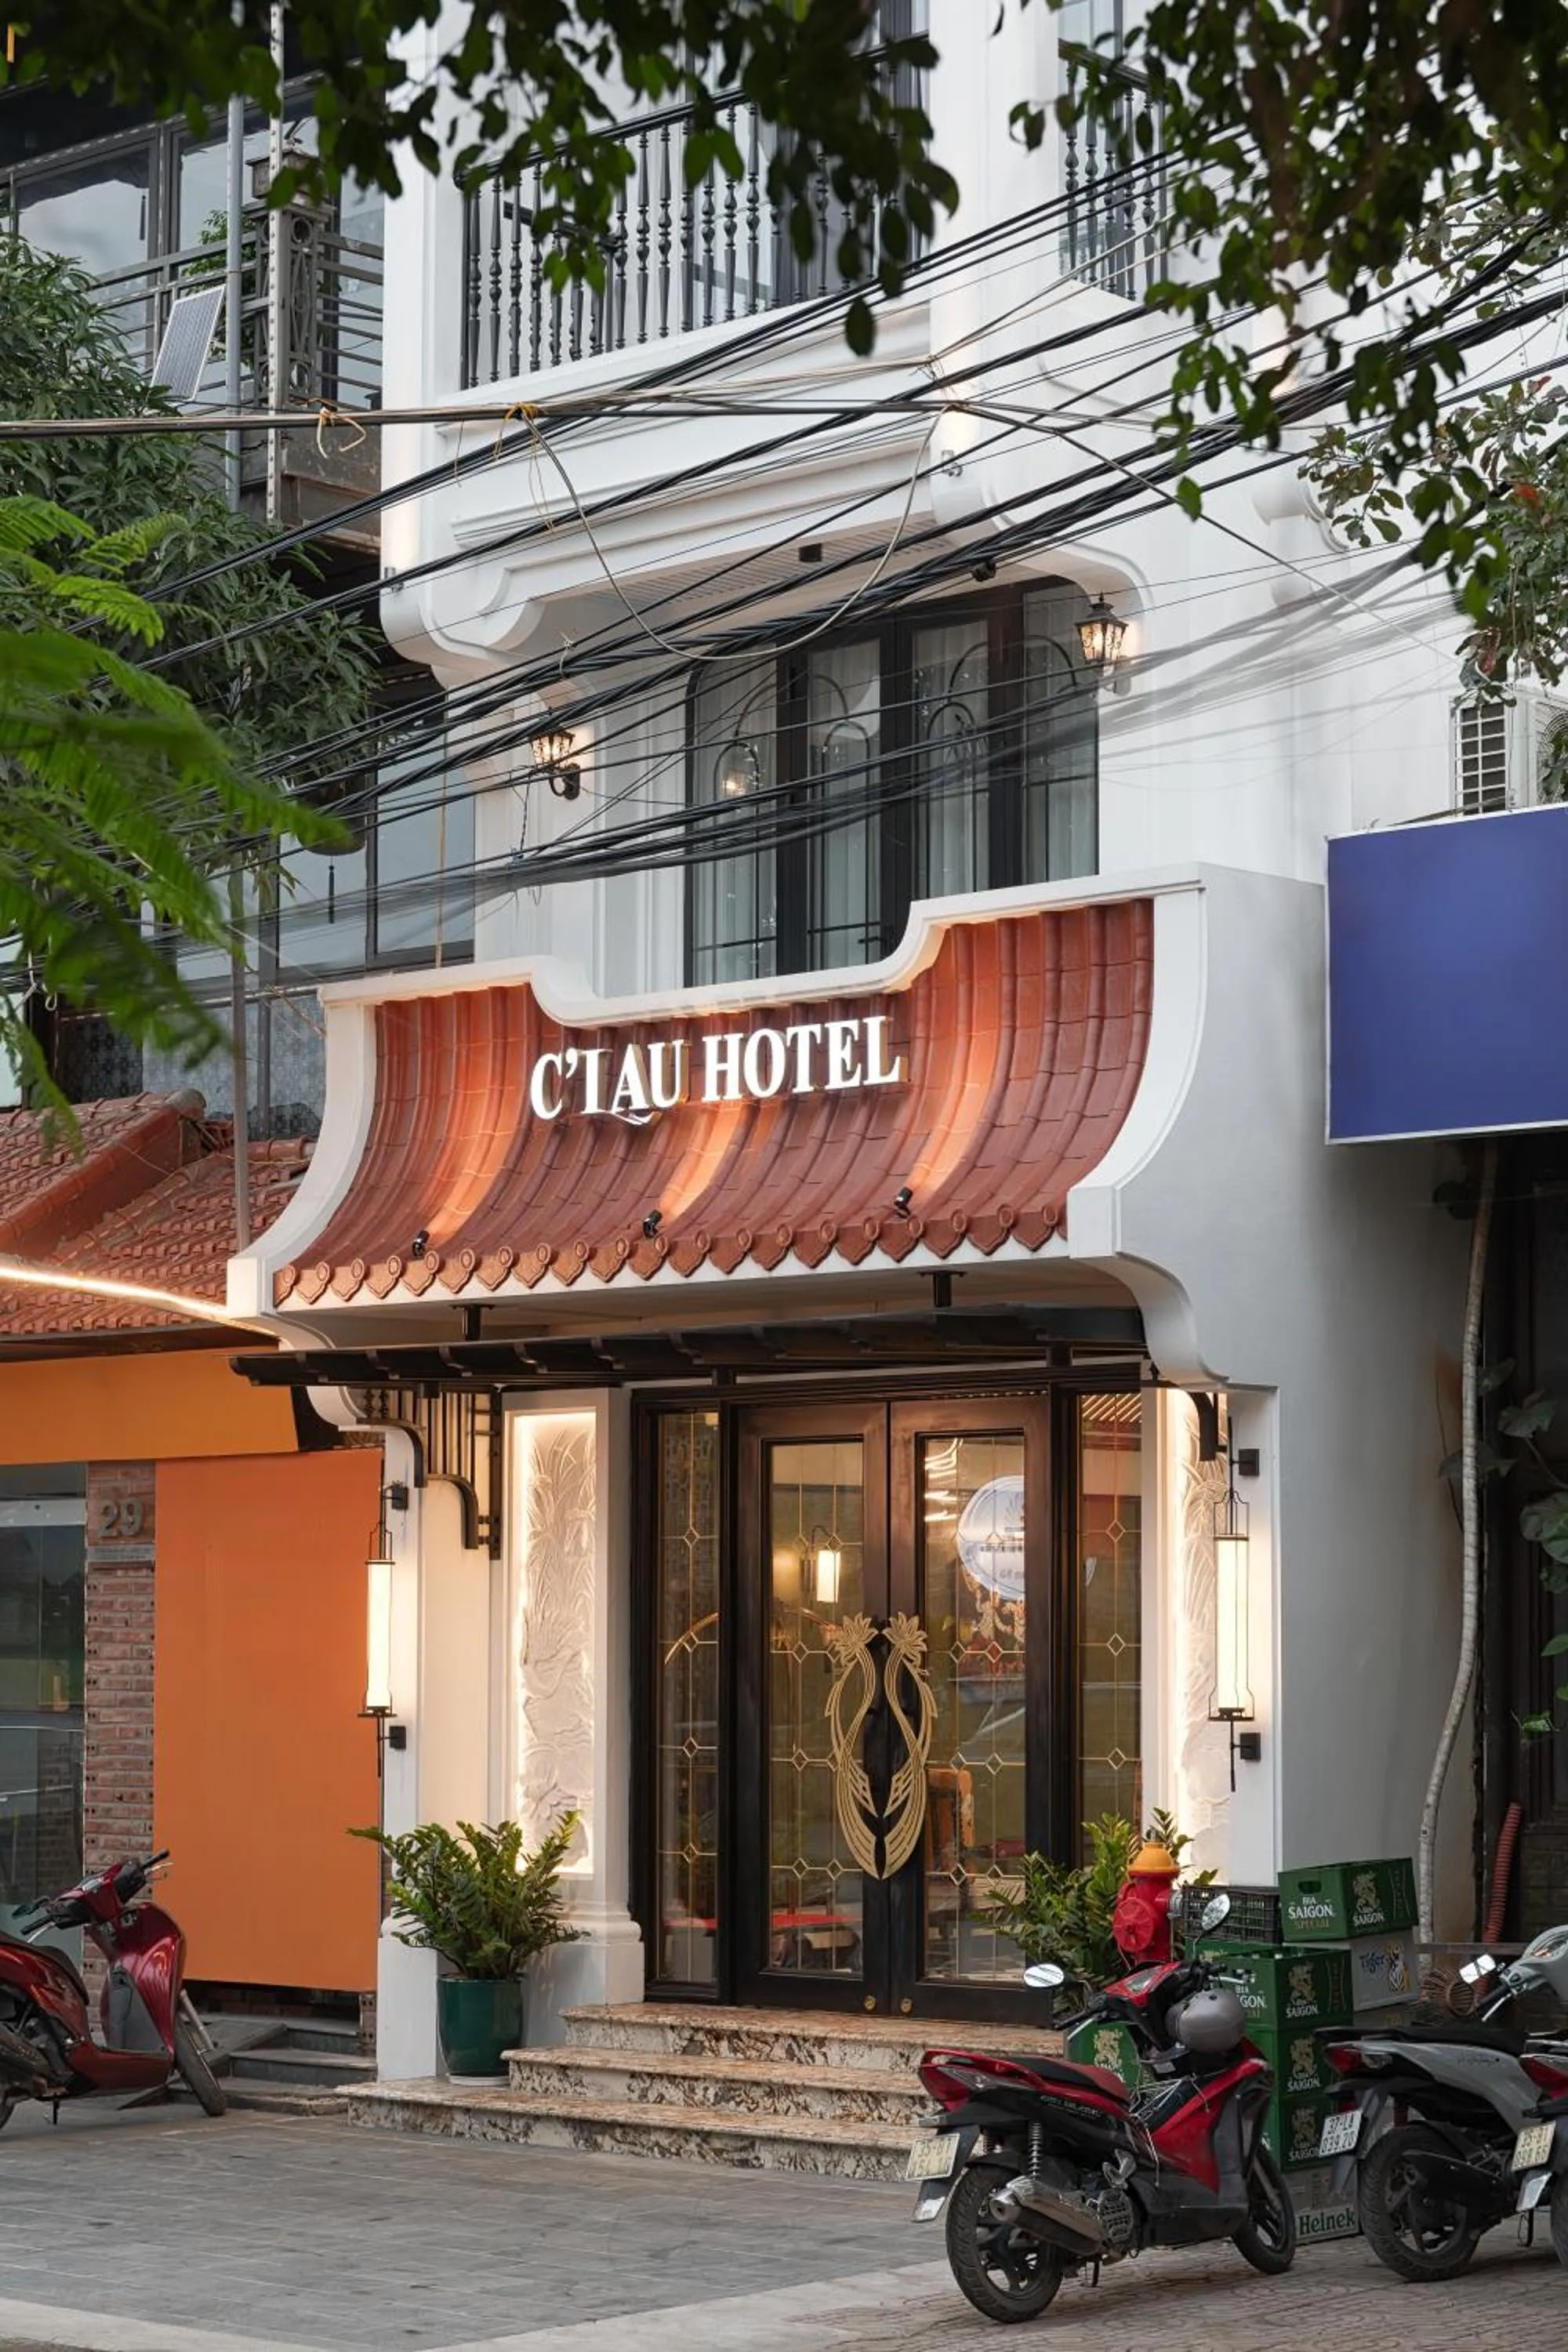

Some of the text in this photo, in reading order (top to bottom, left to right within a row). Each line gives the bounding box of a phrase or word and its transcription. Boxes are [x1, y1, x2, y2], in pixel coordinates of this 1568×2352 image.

[701, 1015, 903, 1102] HOTEL
[97, 1497, 143, 1537] 29
[1287, 1904, 1335, 1920] SAIGON
[1352, 1912, 1385, 1927] SAIGON
[1236, 1994, 1267, 2008] GON
[1285, 2002, 1319, 2019] SAIGON
[1287, 2077, 1321, 2093] SAIGON
[1288, 2147, 1320, 2161] SAIGON
[1299, 2207, 1356, 2236] Heinek
